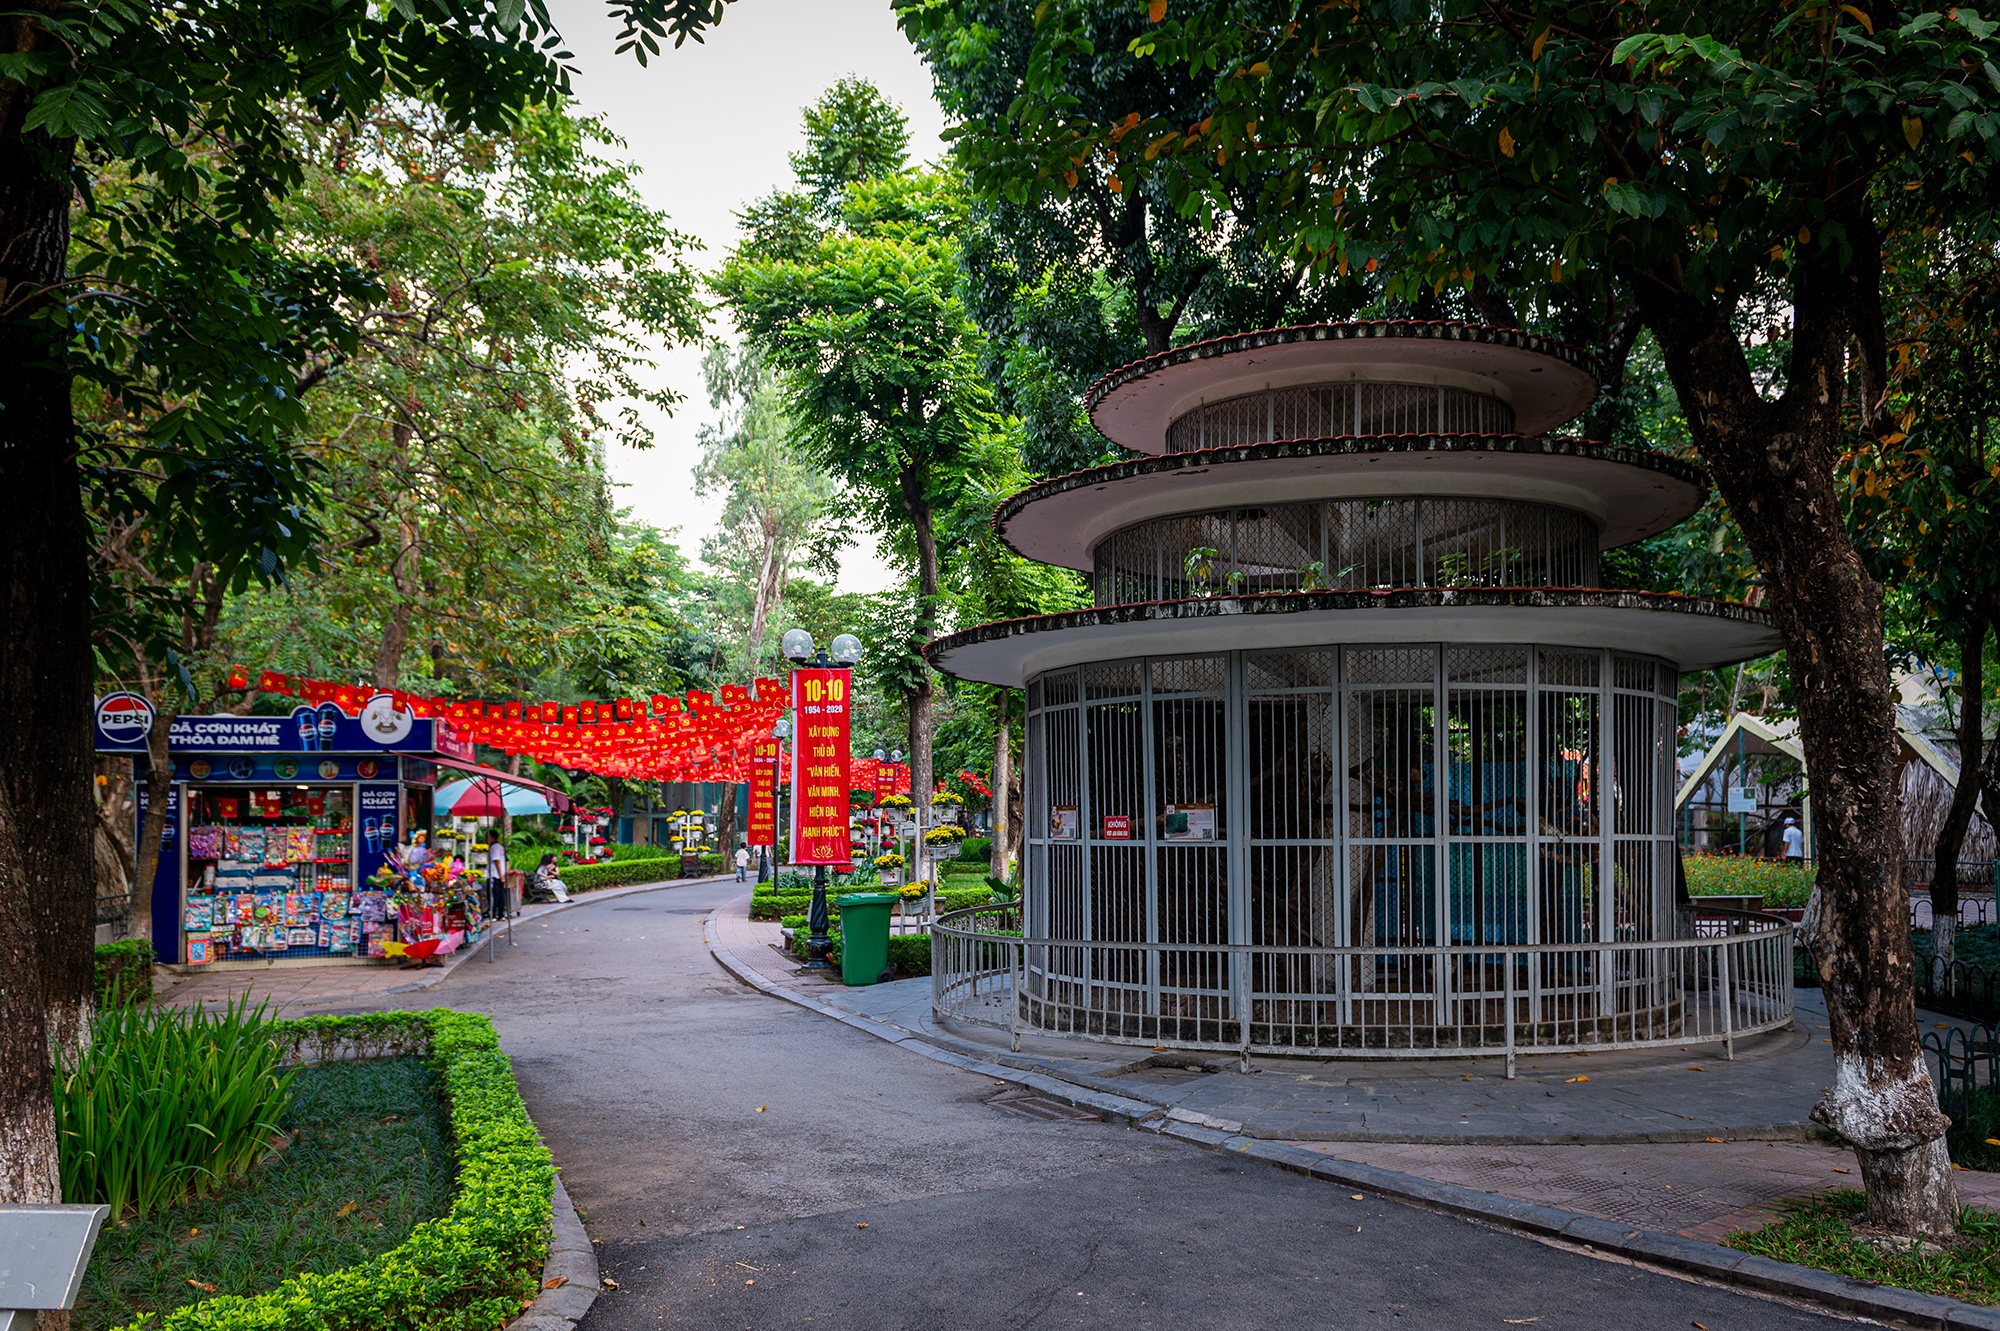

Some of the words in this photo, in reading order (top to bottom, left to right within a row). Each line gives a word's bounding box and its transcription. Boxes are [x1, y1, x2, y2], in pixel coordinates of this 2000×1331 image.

[804, 679, 844, 702] 10-10
[804, 705, 821, 714] 1954
[826, 705, 843, 714] 2026
[101, 714, 149, 725] PEPSI
[194, 723, 232, 733] CƠN
[233, 722, 281, 734] KHÁT
[808, 725, 821, 738] XÂY
[822, 726, 840, 739] DỰNG
[217, 735, 254, 745] ĐAM
[255, 734, 280, 745] MÊ
[813, 743, 825, 757] THỦ
[826, 744, 836, 757] ĐÔ
[808, 785, 821, 797] VĂN
[821, 786, 841, 798] MINH,
[809, 804, 825, 819] HIỆN
[1107, 819, 1127, 828] KHÔNG
[802, 826, 821, 839] HẠNH
